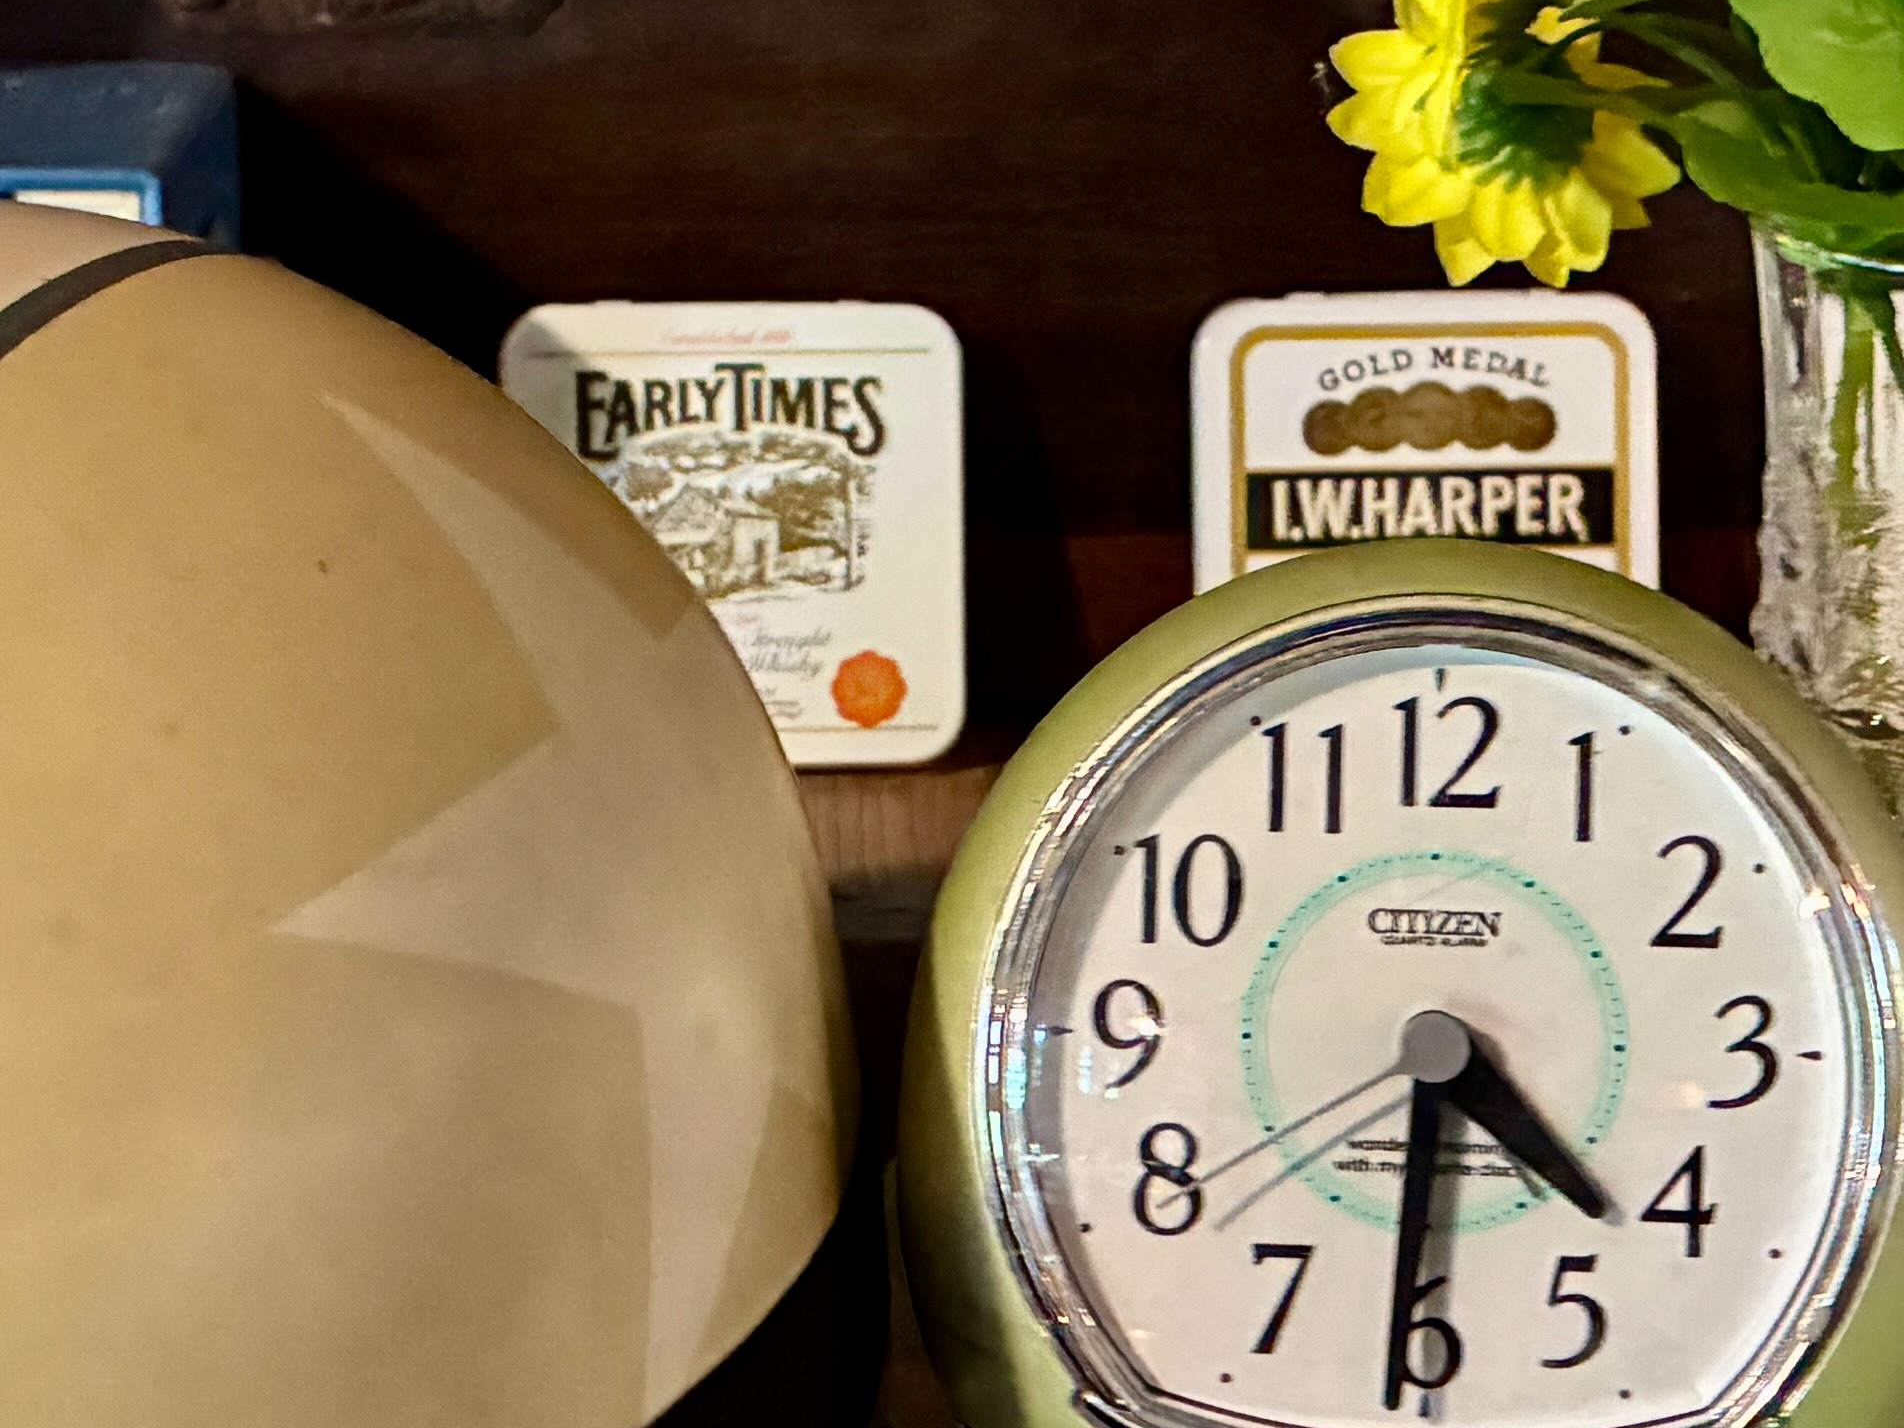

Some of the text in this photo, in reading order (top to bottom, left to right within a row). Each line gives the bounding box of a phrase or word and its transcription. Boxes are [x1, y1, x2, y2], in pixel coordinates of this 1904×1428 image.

[575, 362, 885, 461] EARLY TIMES
[1317, 344, 1551, 392] GOLD MEDAL
[1262, 722, 1347, 835] 11
[1393, 695, 1503, 808] 12
[1568, 731, 1598, 842] 1
[1134, 833, 1243, 947] 10
[1368, 908, 1502, 936] CITIZEN
[1650, 835, 1723, 949] 2
[1094, 980, 1161, 1088] 9
[1708, 996, 1778, 1109] 3
[1133, 1123, 1202, 1236] 8
[1641, 1146, 1717, 1258] 4
[1252, 1244, 1314, 1355] 7
[1398, 1274, 1464, 1390] 6
[1541, 1254, 1606, 1369] 5
